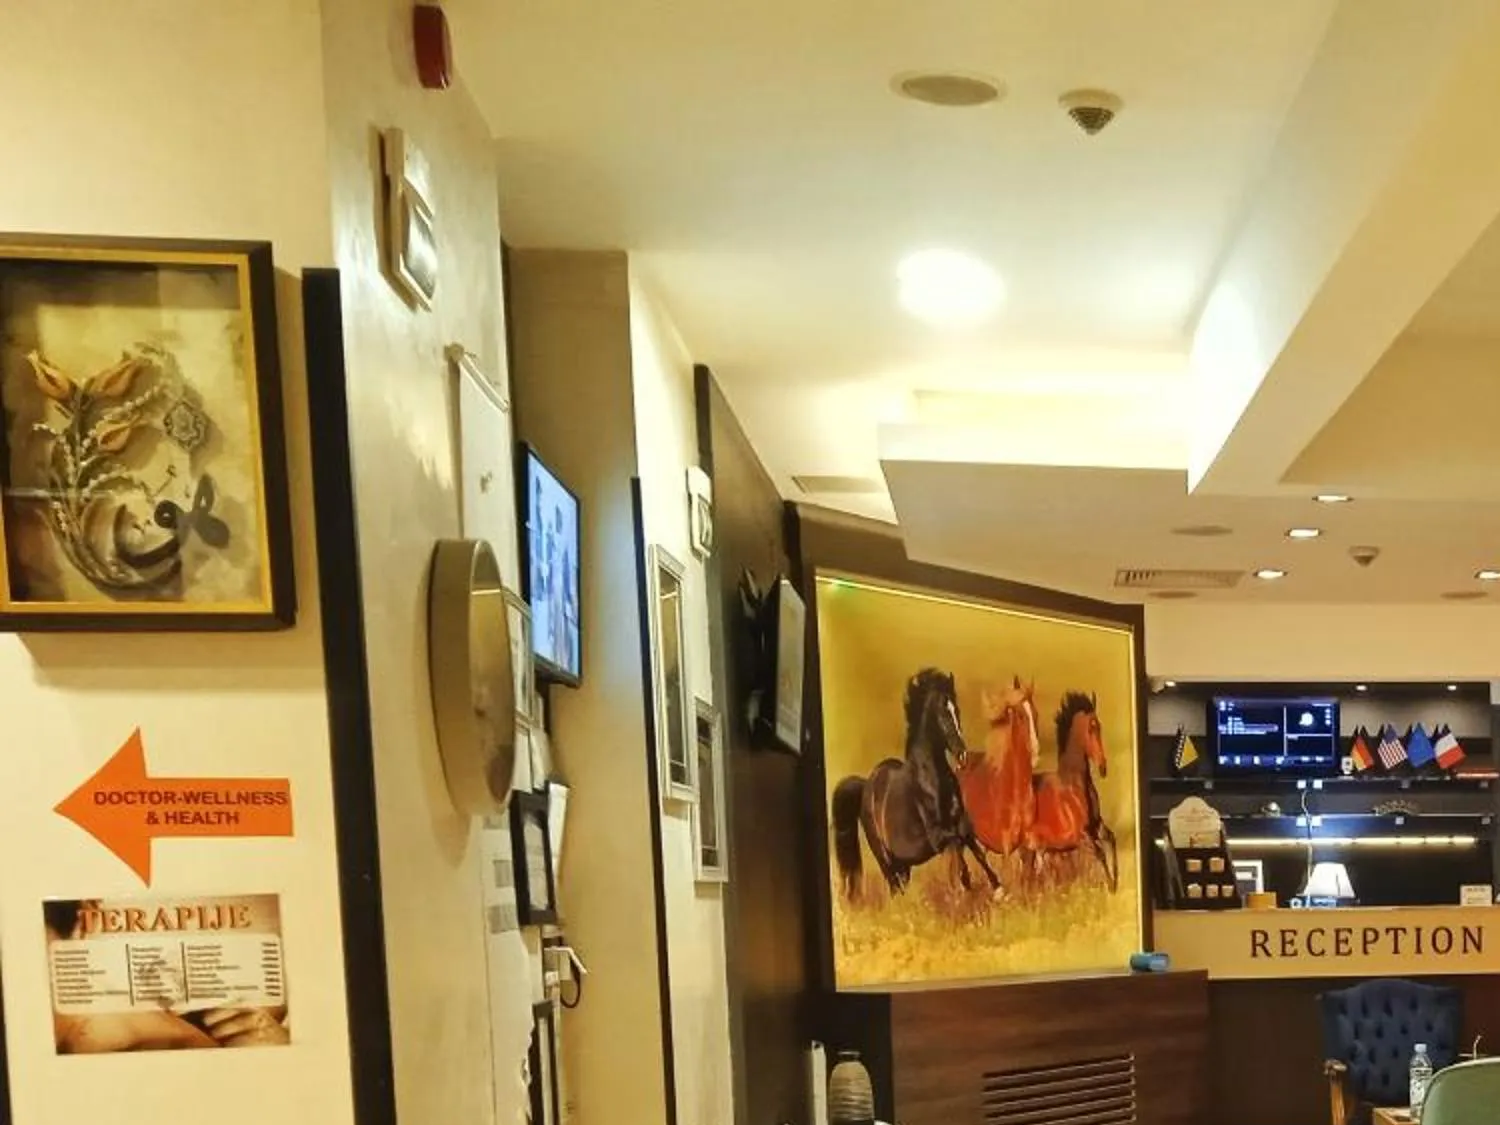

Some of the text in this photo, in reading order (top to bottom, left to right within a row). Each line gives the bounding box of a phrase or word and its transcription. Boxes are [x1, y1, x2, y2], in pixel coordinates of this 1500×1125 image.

[94, 790, 288, 806] DOCTOR-WELLNESS
[146, 811, 240, 826] & HEALTH
[77, 904, 252, 934] TERAPIJE
[1250, 925, 1485, 958] RECEPTION
